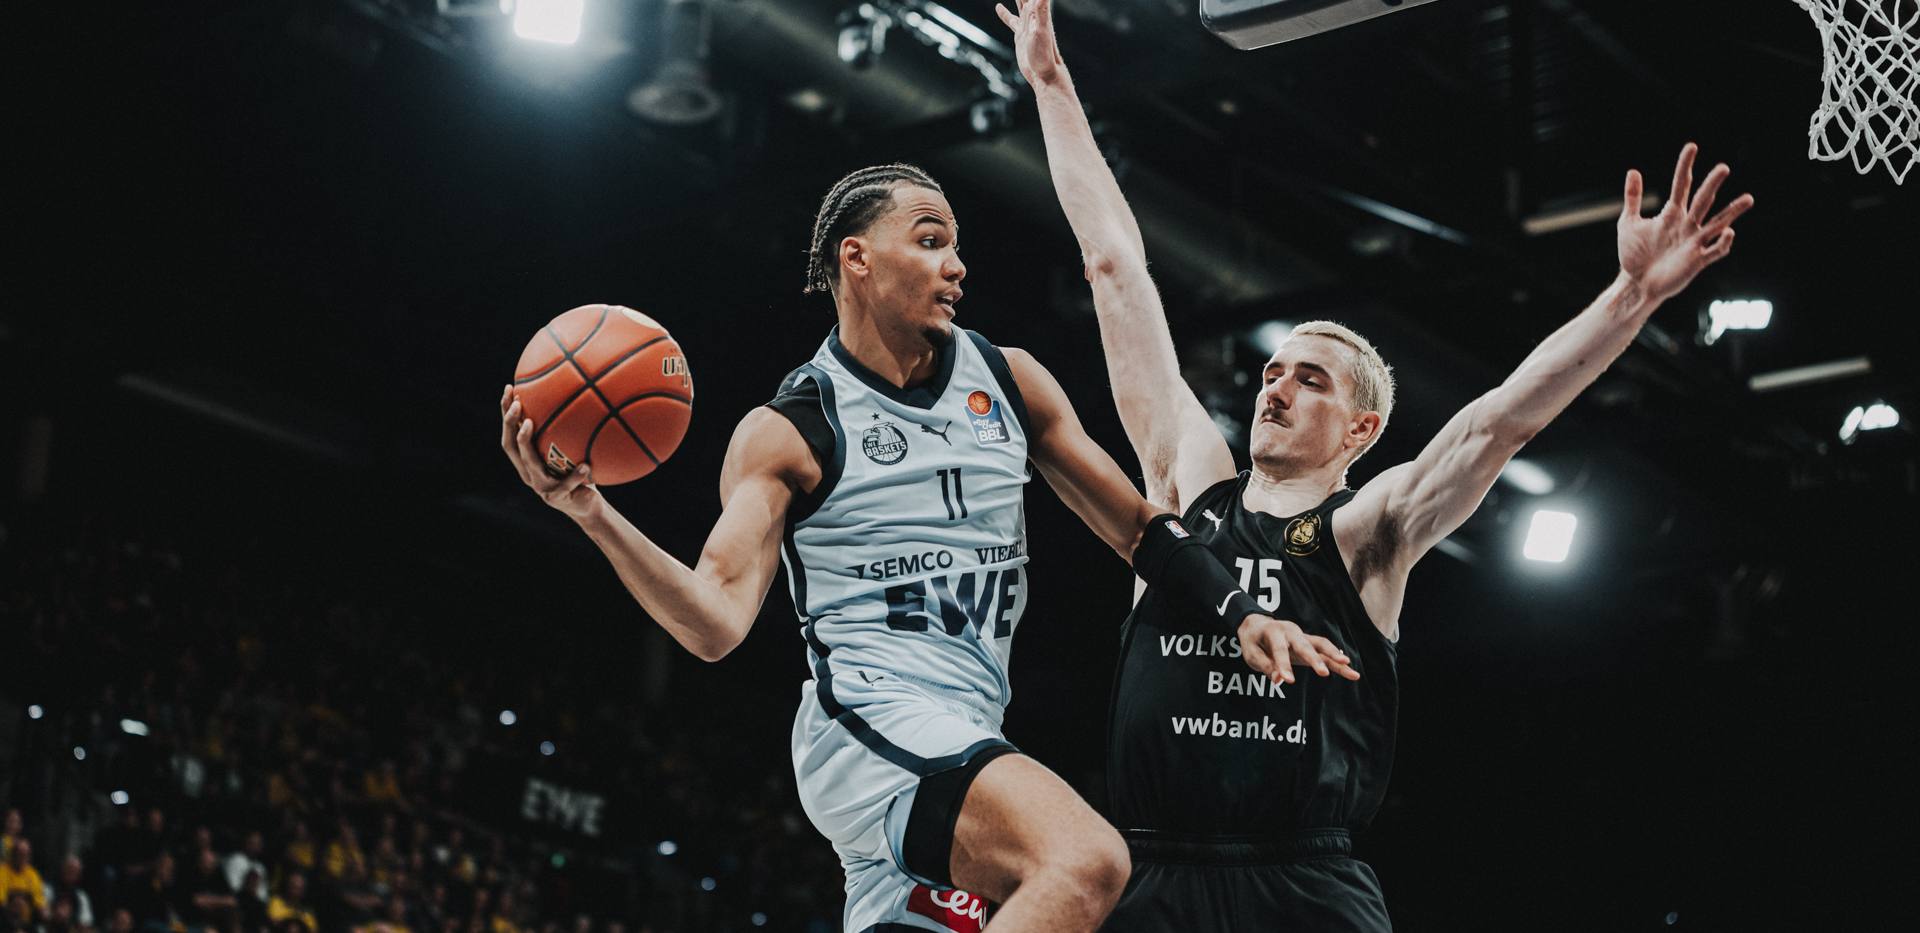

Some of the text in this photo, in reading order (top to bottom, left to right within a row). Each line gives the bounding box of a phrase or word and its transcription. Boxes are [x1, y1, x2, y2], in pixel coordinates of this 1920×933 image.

[865, 441, 907, 457] BASKETS
[979, 428, 1006, 442] BBL
[936, 467, 968, 521] 11
[870, 550, 954, 579] SEMCO
[1235, 556, 1283, 613] 15
[884, 567, 1020, 640] EWE
[1159, 634, 1242, 658] VOLKS
[1207, 670, 1286, 699] BANK
